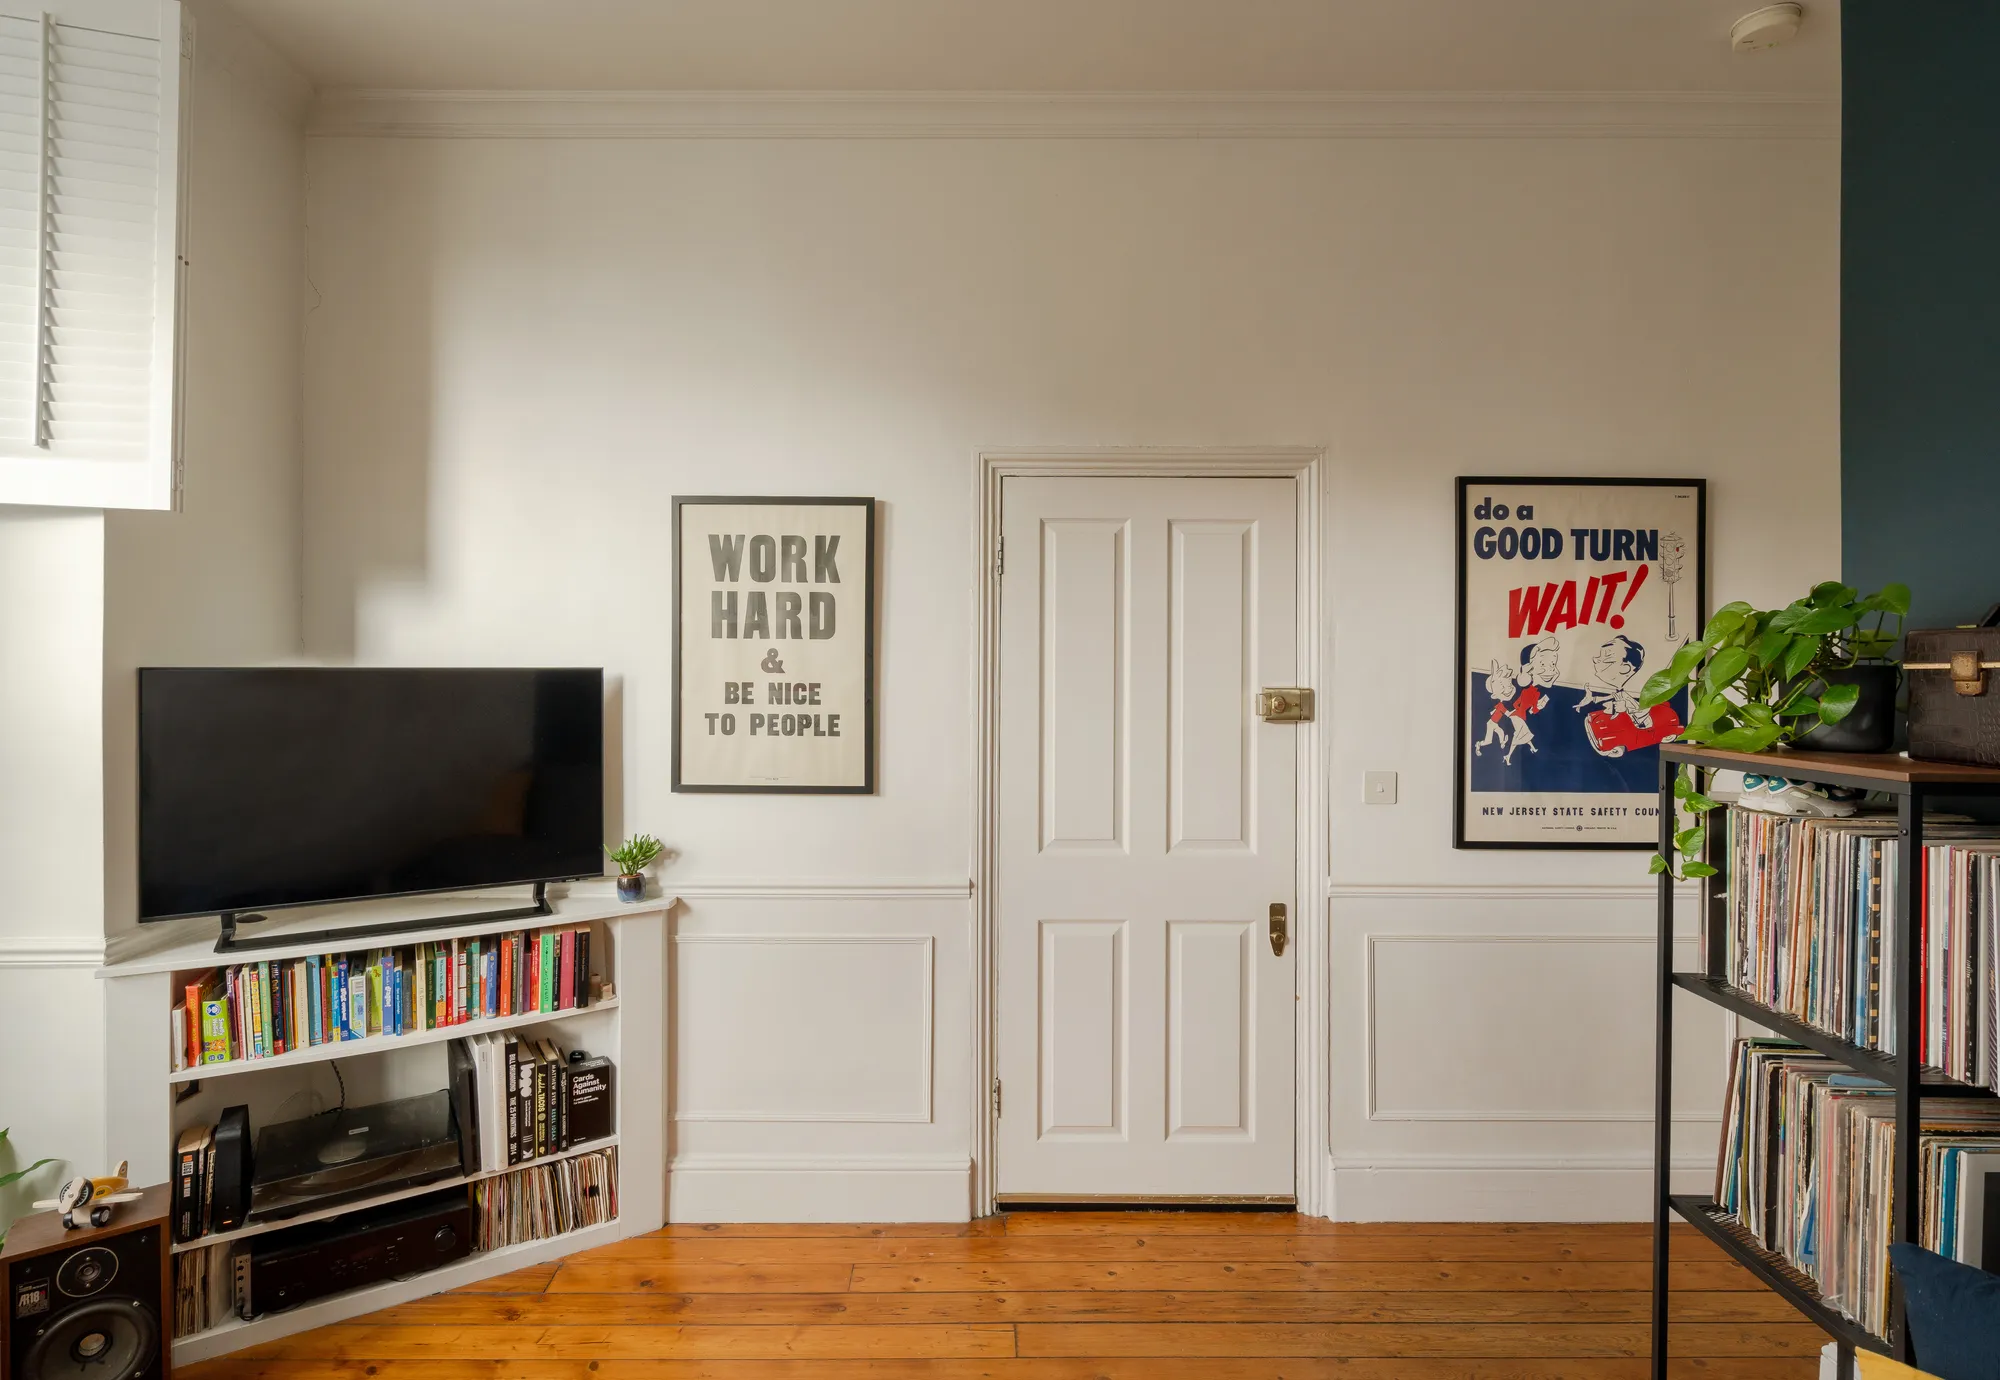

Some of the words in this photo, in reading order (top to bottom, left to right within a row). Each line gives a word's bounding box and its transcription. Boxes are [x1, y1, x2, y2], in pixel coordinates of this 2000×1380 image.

[1474, 497, 1509, 521] do
[1516, 504, 1534, 521] a
[1473, 527, 1564, 561] GOOD
[1570, 529, 1659, 562] TURN
[708, 534, 841, 584] WORK
[1508, 564, 1649, 639] WAIT!
[711, 590, 836, 640] HARD
[760, 647, 786, 674] &
[724, 682, 755, 705] BE
[768, 682, 822, 706] NICE
[704, 712, 736, 736] TO
[750, 713, 841, 737] PEOPLE
[1482, 806, 1504, 816] NEW
[1510, 806, 1547, 816] JERSEY
[1553, 806, 1584, 817] STATE
[1590, 806, 1629, 817] SAFETY
[572, 1083, 607, 1096] Humanity
[573, 1074, 594, 1083] Cards
[573, 1078, 600, 1090] Against
[509, 1096, 517, 1107] THE
[537, 1093, 545, 1112] TACOS
